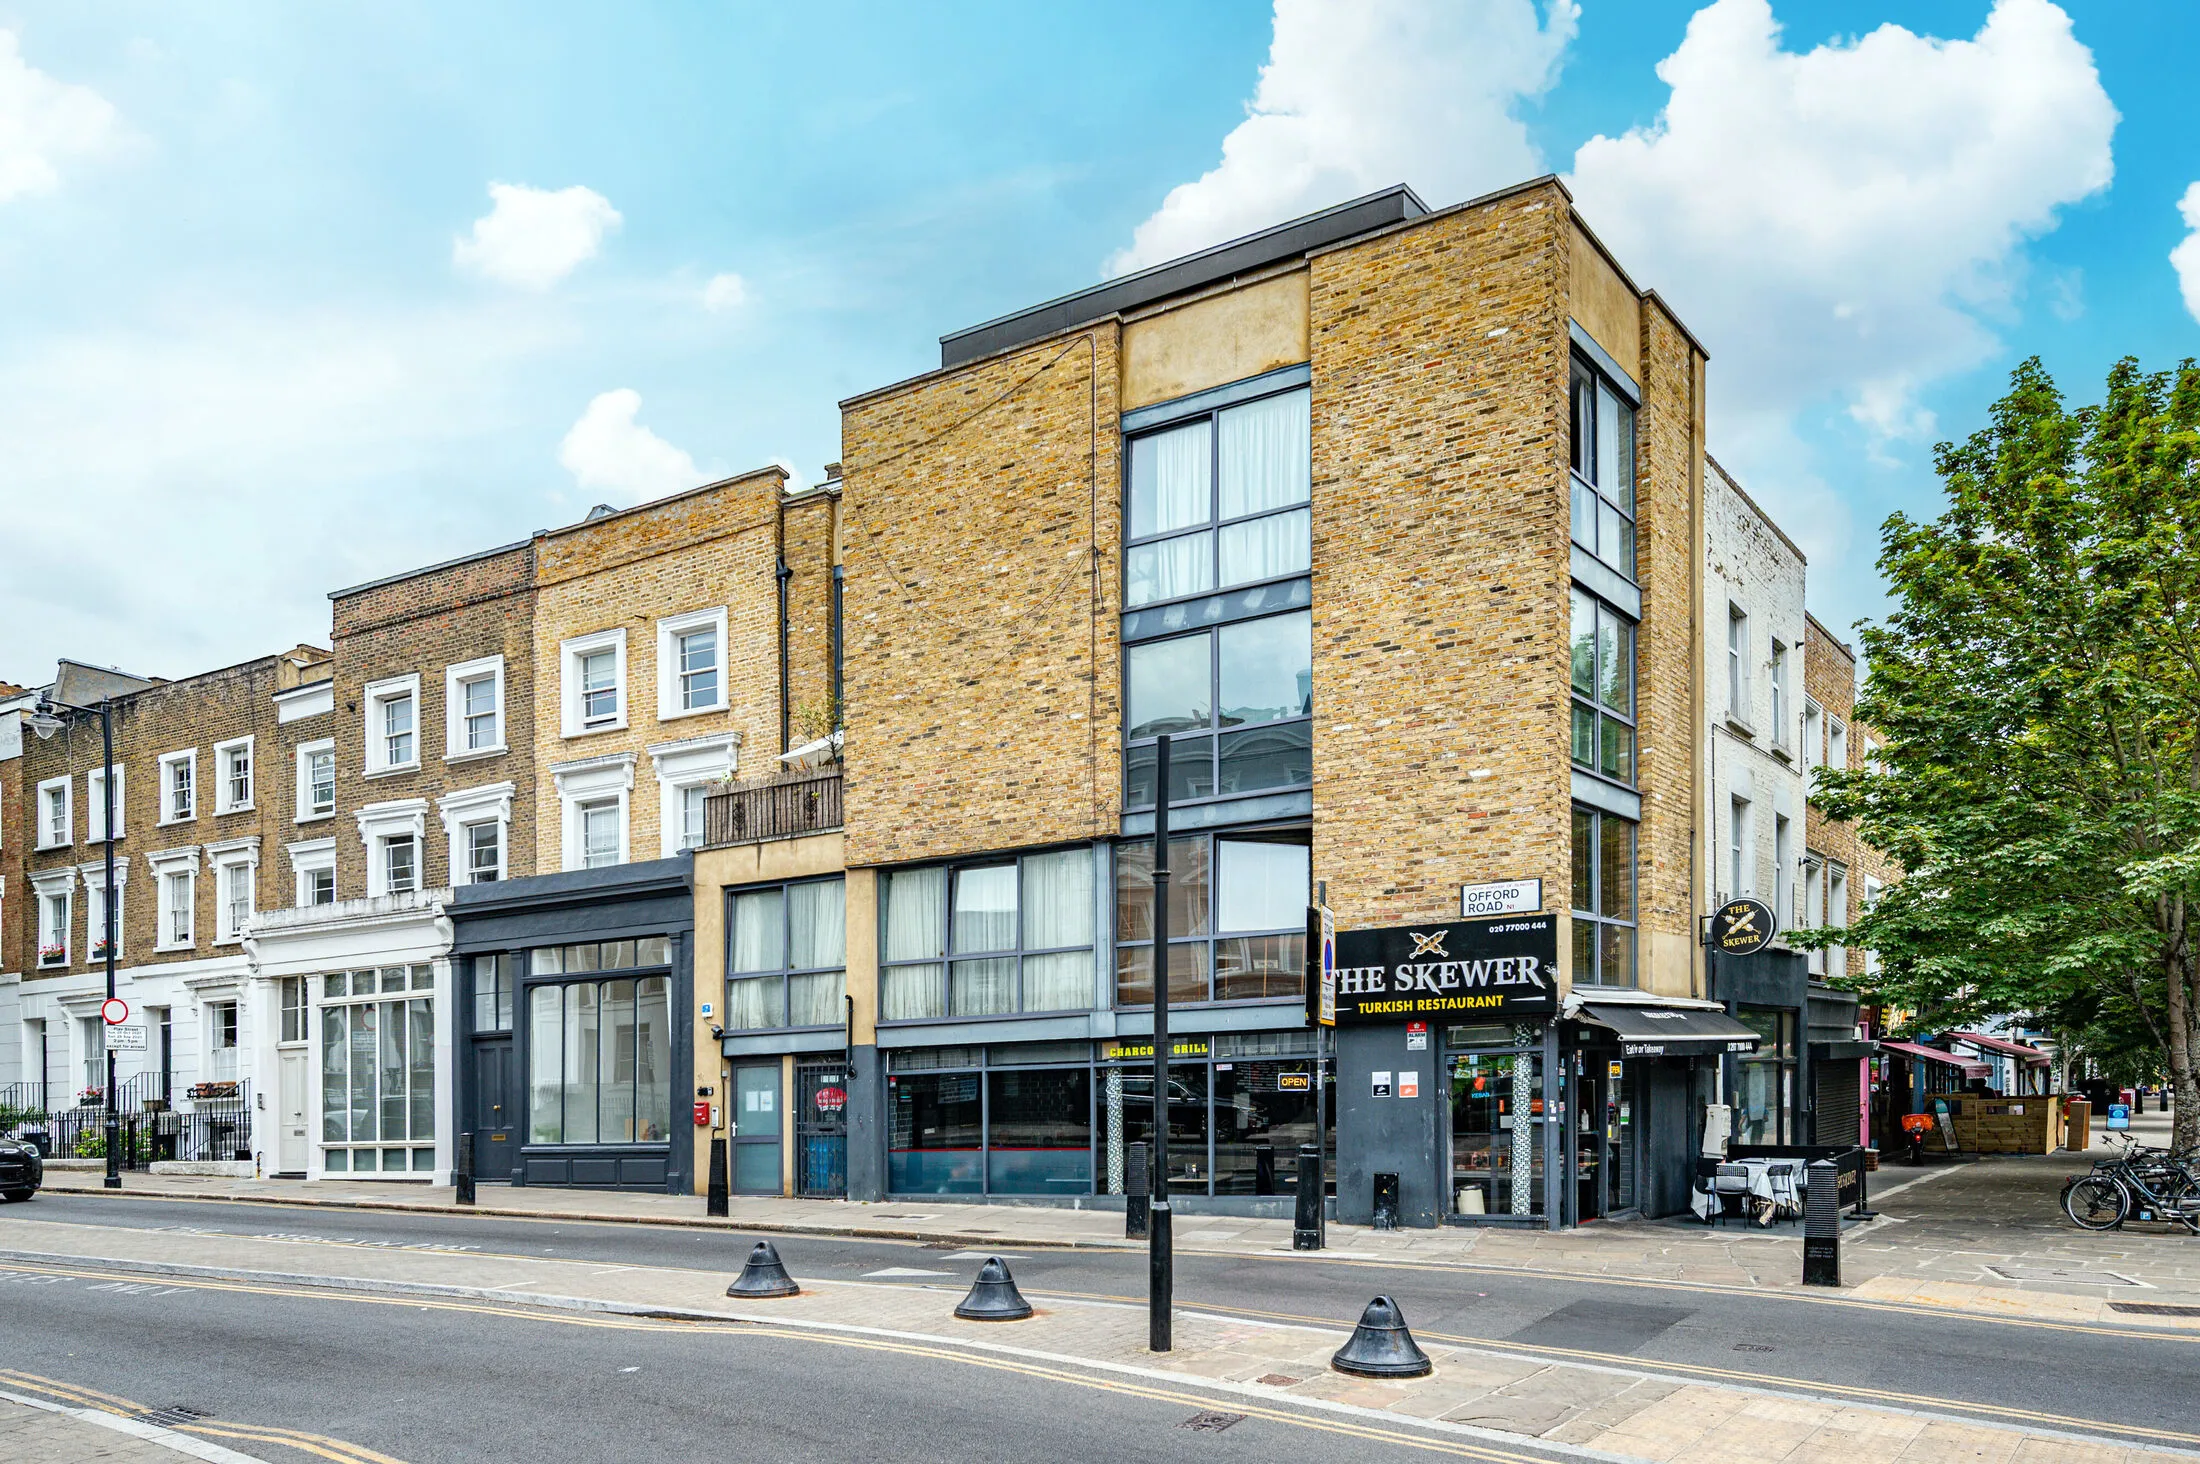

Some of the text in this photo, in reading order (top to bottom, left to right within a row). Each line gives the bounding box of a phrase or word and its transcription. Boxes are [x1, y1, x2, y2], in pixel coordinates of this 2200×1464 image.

[1468, 888, 1519, 902] OFFORD
[1468, 901, 1503, 913] ROAD
[1727, 904, 1750, 915] THE
[1489, 921, 1547, 933] 020 77000 444
[1723, 935, 1761, 947] SKEWER
[1395, 957, 1546, 995] SKEWER
[1358, 995, 1504, 1014] TURKISH RESTAURANT
[1109, 1044, 1208, 1057] CHARCO GRILL
[1281, 1077, 1307, 1087] OPEN
[86, 1282, 196, 1297] ONLY
